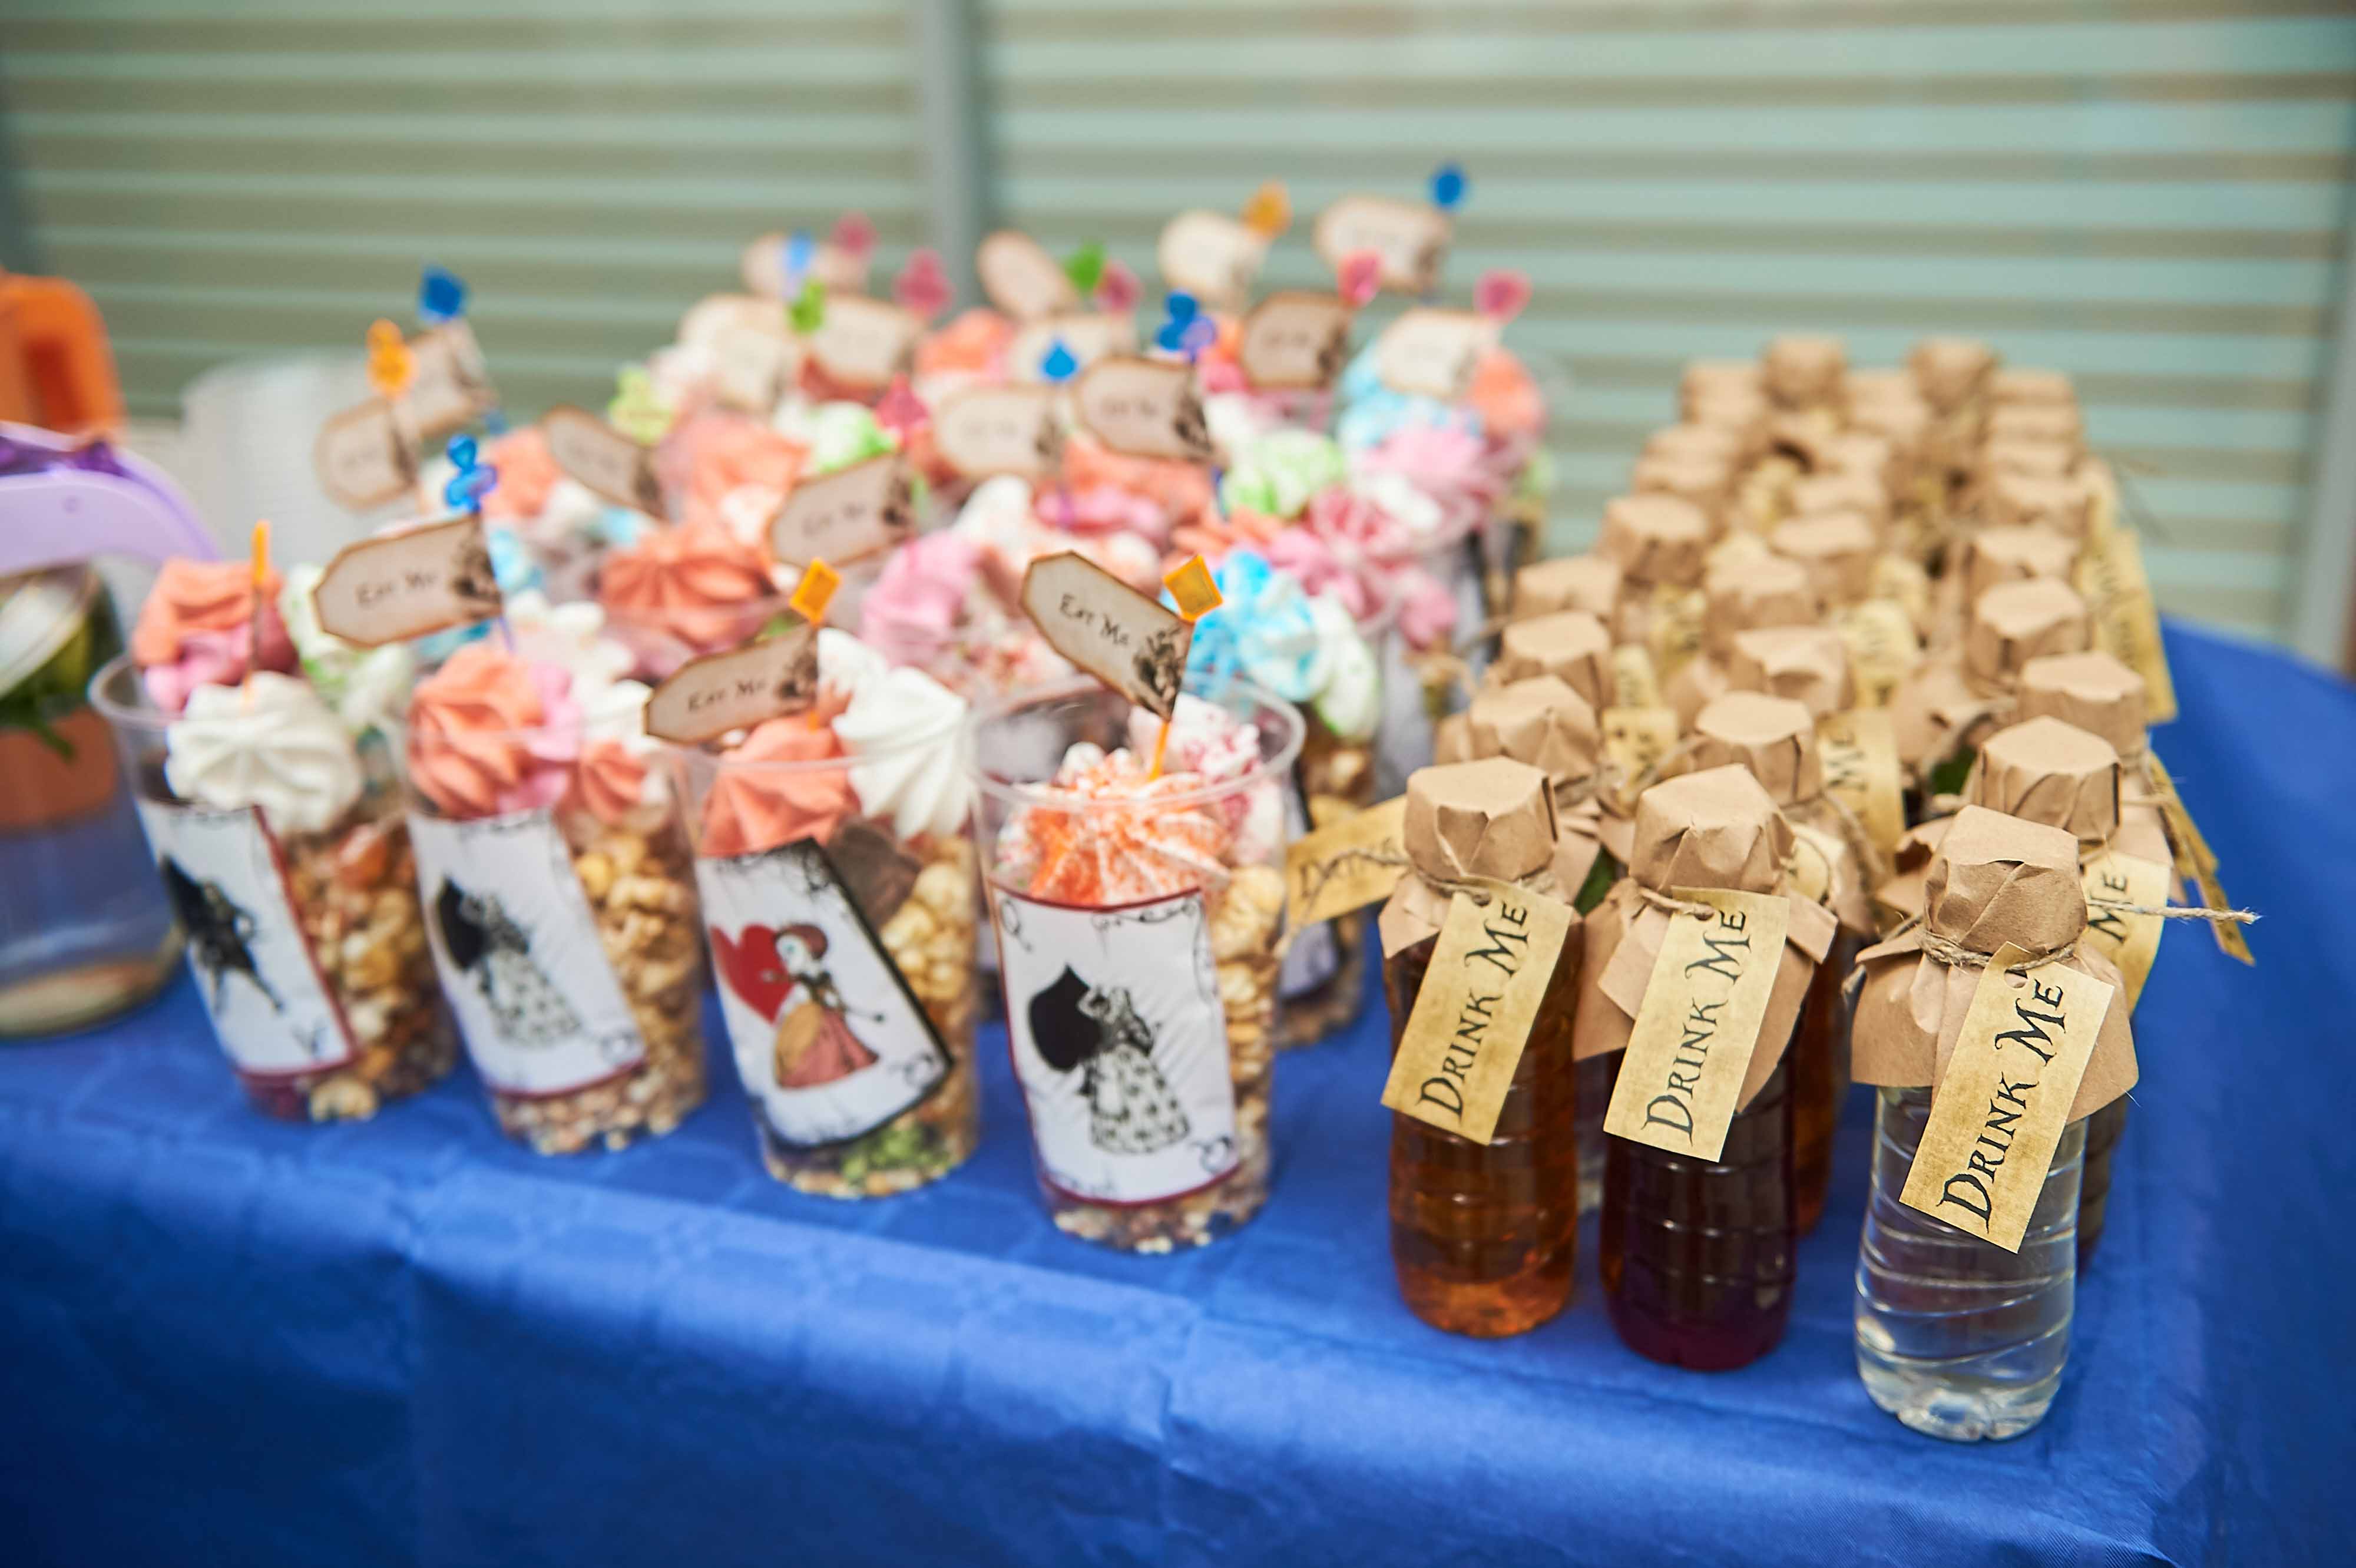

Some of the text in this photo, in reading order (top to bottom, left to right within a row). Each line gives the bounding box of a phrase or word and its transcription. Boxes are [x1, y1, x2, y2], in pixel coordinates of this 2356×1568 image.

[1415, 901, 1529, 1122] DRINK ME
[1641, 909, 1752, 1146] DRINK ME
[1935, 978, 2066, 1233] DRINK ME
